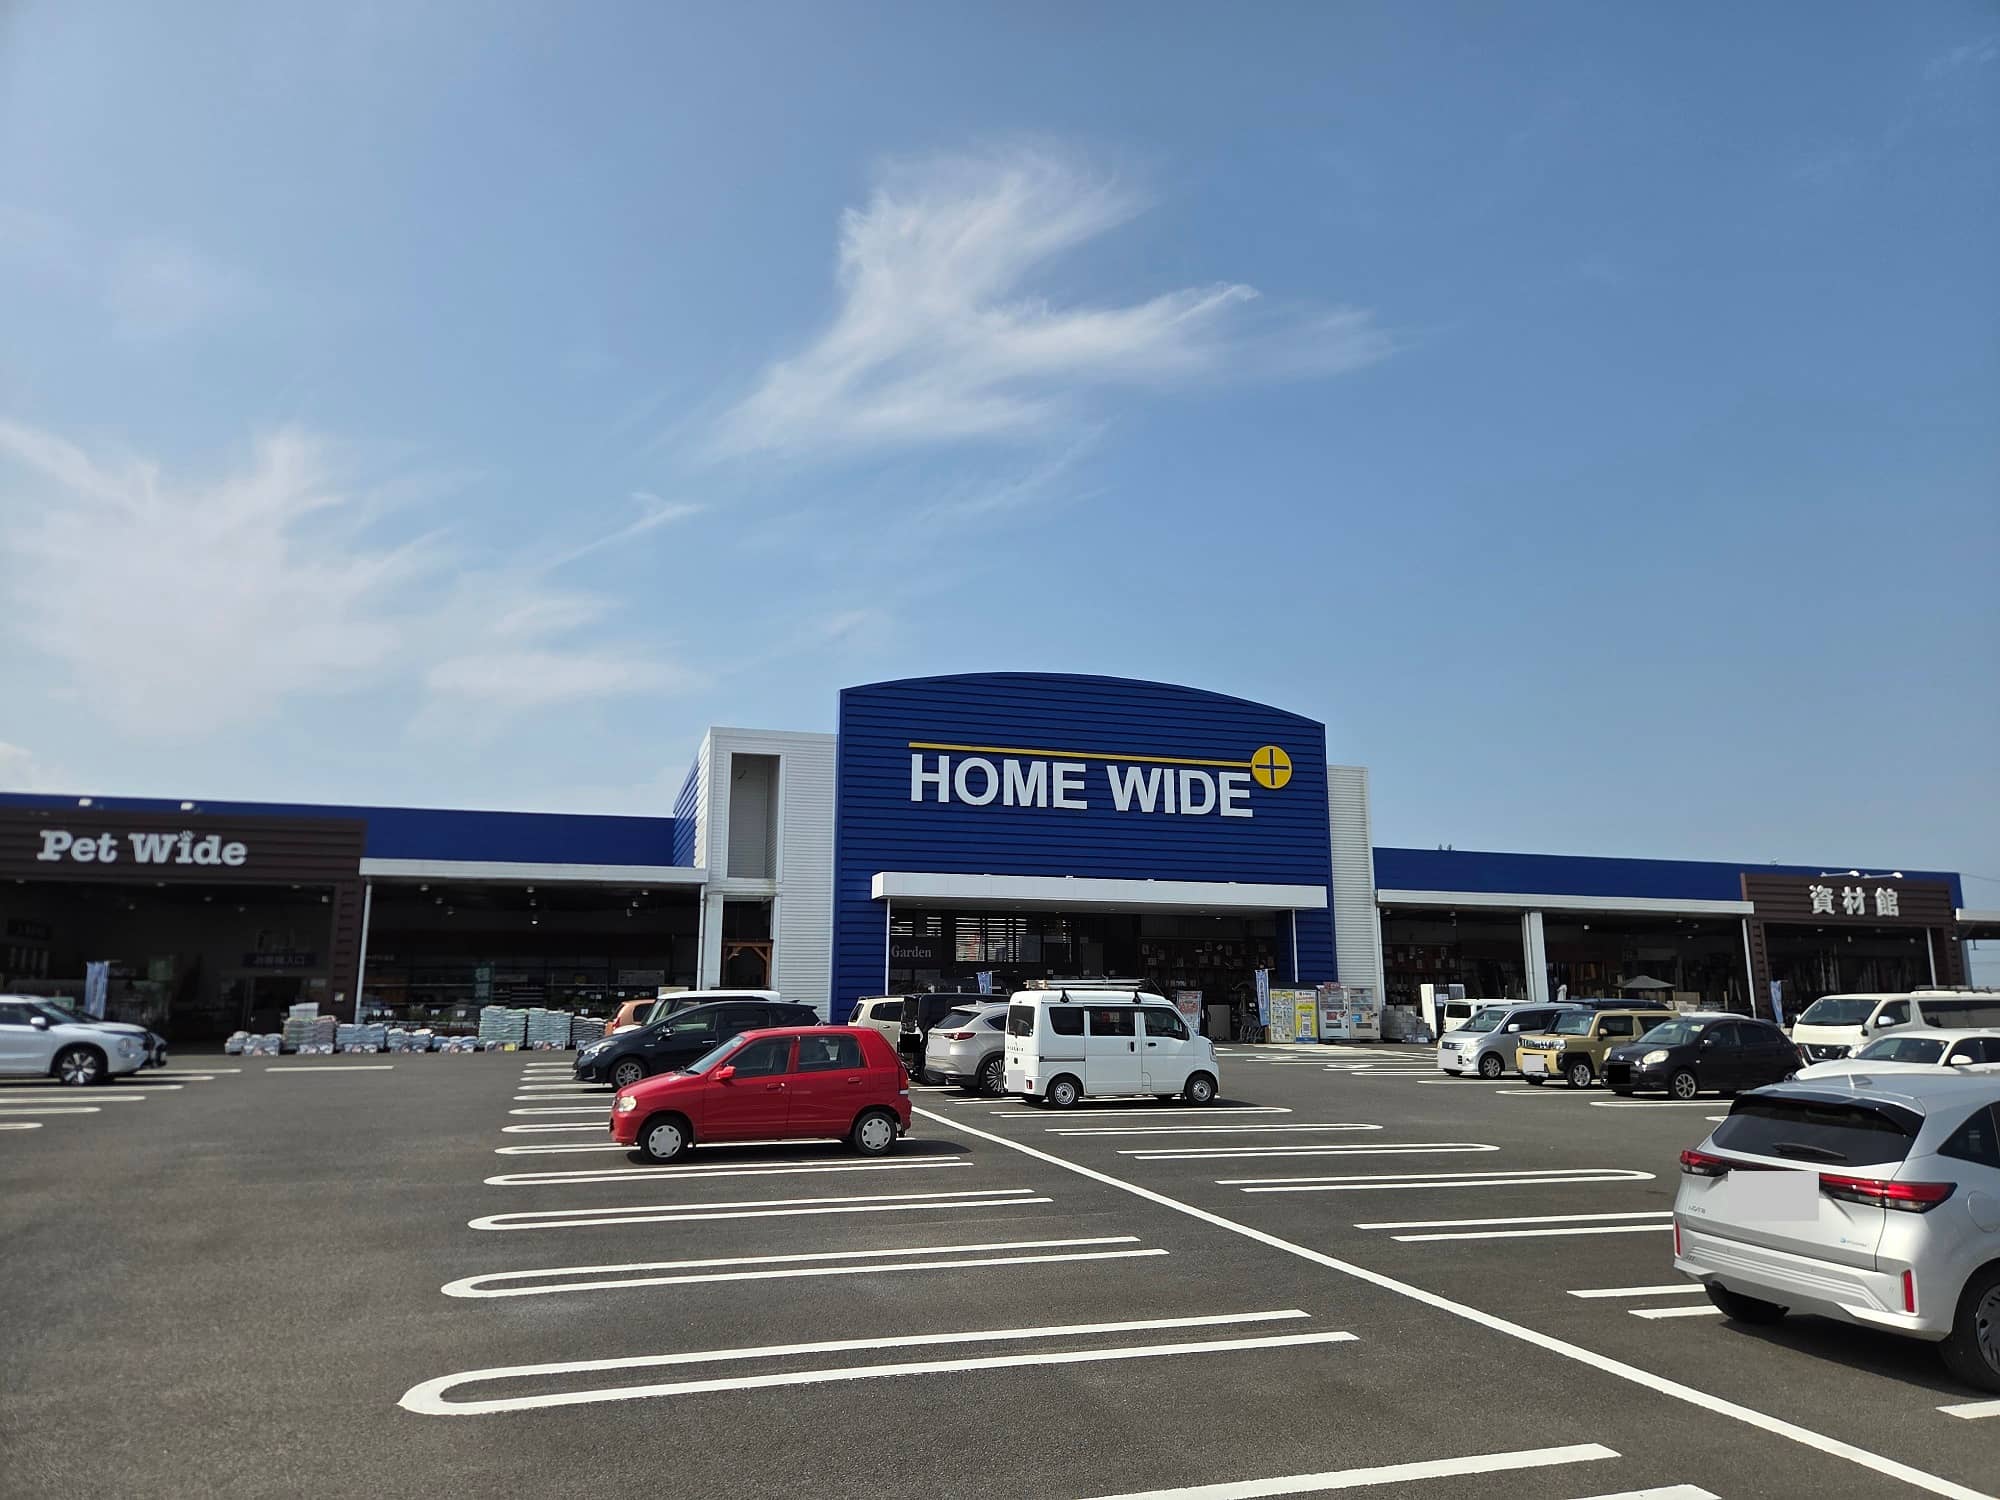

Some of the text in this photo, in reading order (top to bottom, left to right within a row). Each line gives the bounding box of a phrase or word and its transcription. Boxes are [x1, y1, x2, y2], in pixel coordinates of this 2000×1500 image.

[910, 753, 1254, 818] HOME WIDE
[36, 829, 248, 866] Pet Wide
[1809, 884, 1901, 917] 資材館
[891, 944, 932, 958] Garden
